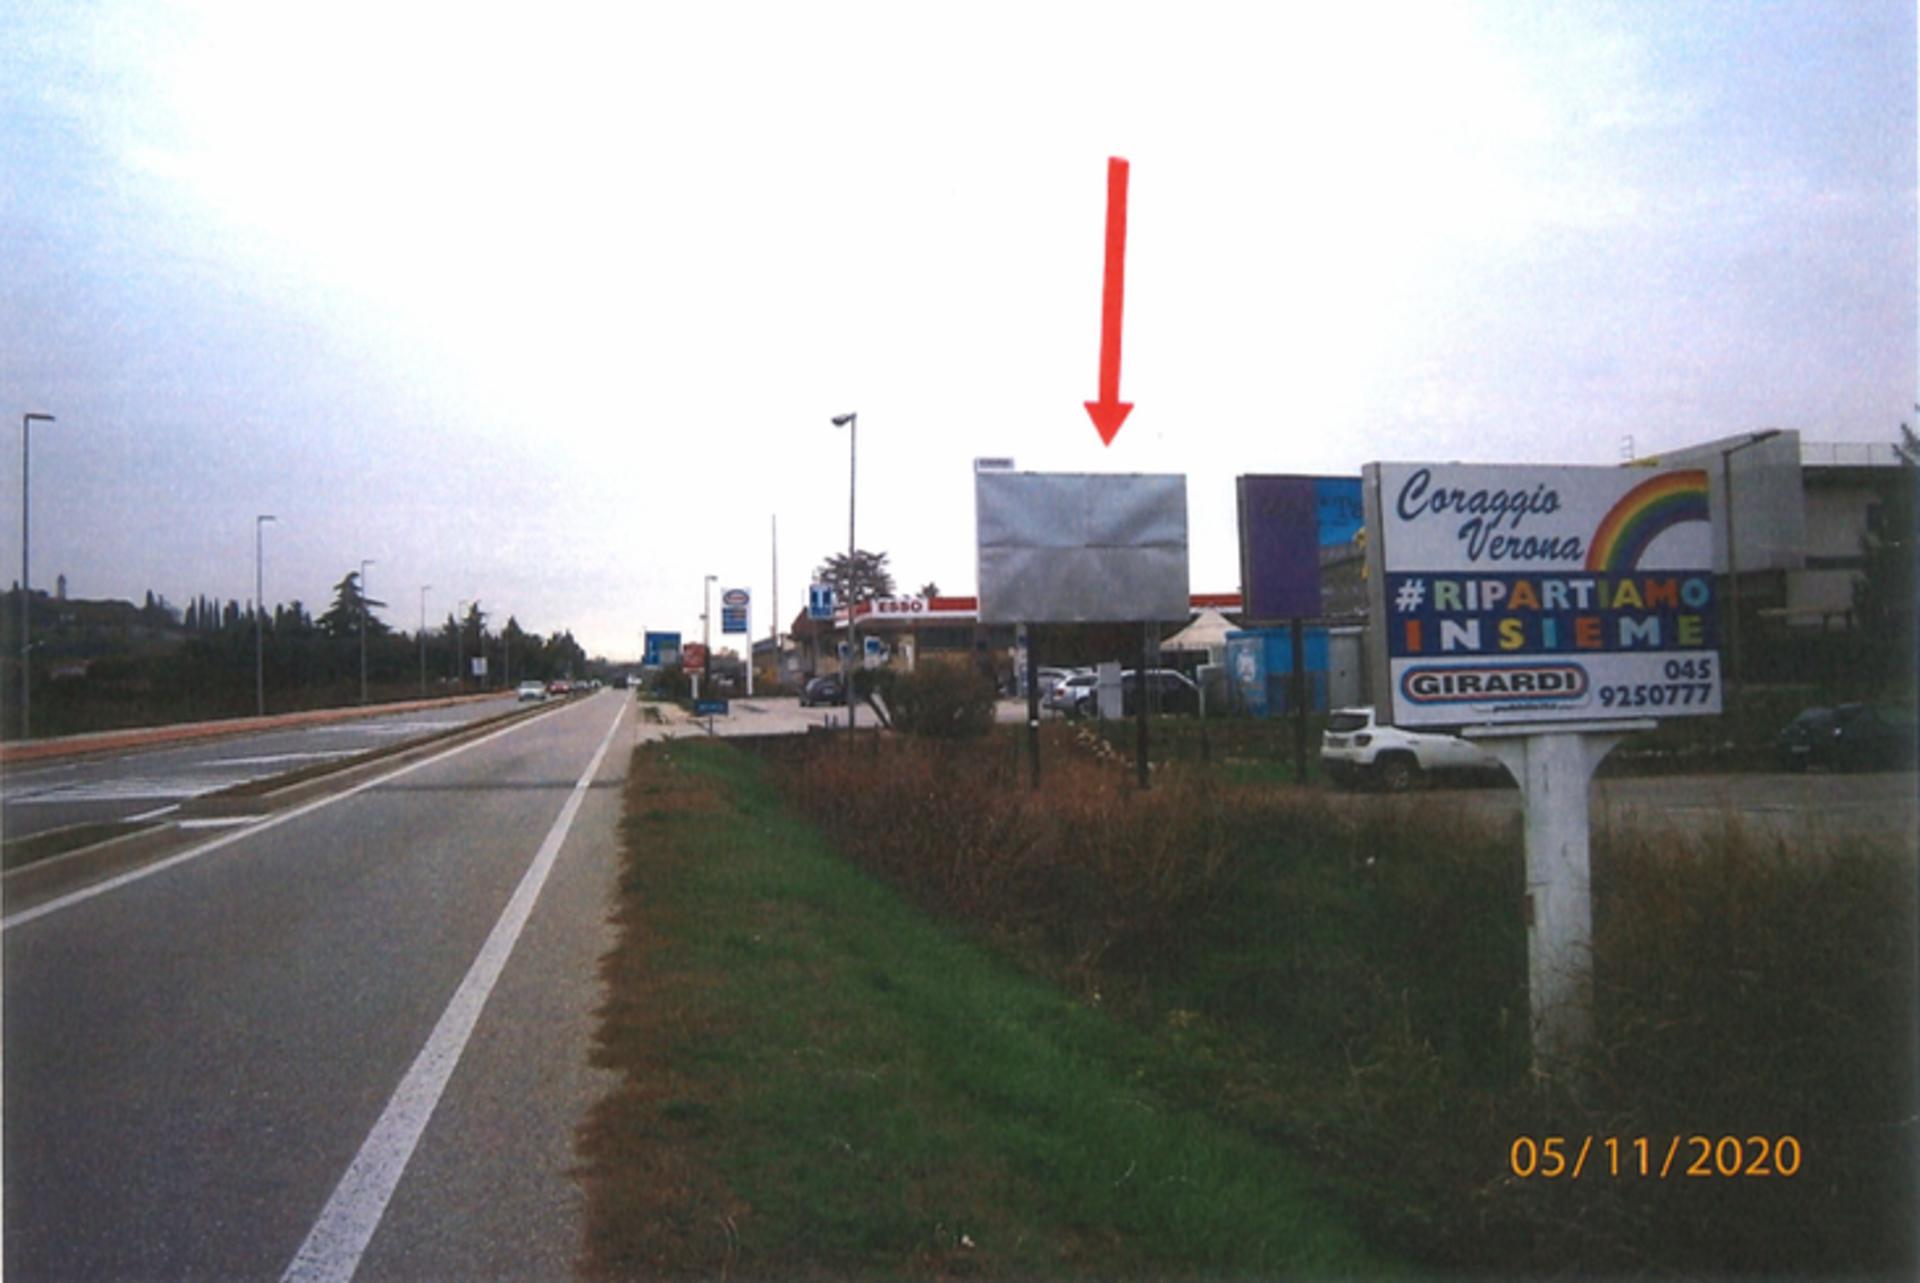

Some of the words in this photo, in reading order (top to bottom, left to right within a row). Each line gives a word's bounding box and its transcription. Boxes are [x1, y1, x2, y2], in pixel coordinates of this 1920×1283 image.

[1397, 468, 1561, 530] Coraggio
[1458, 516, 1583, 561] Verona
[879, 600, 922, 613] ESSO
[1395, 578, 1710, 612] #RIPARTIAMO
[1405, 615, 1704, 650] INSIEME
[1411, 671, 1577, 696] GIRARDI
[1664, 659, 1711, 680] 045
[1600, 683, 1712, 708] 9250777
